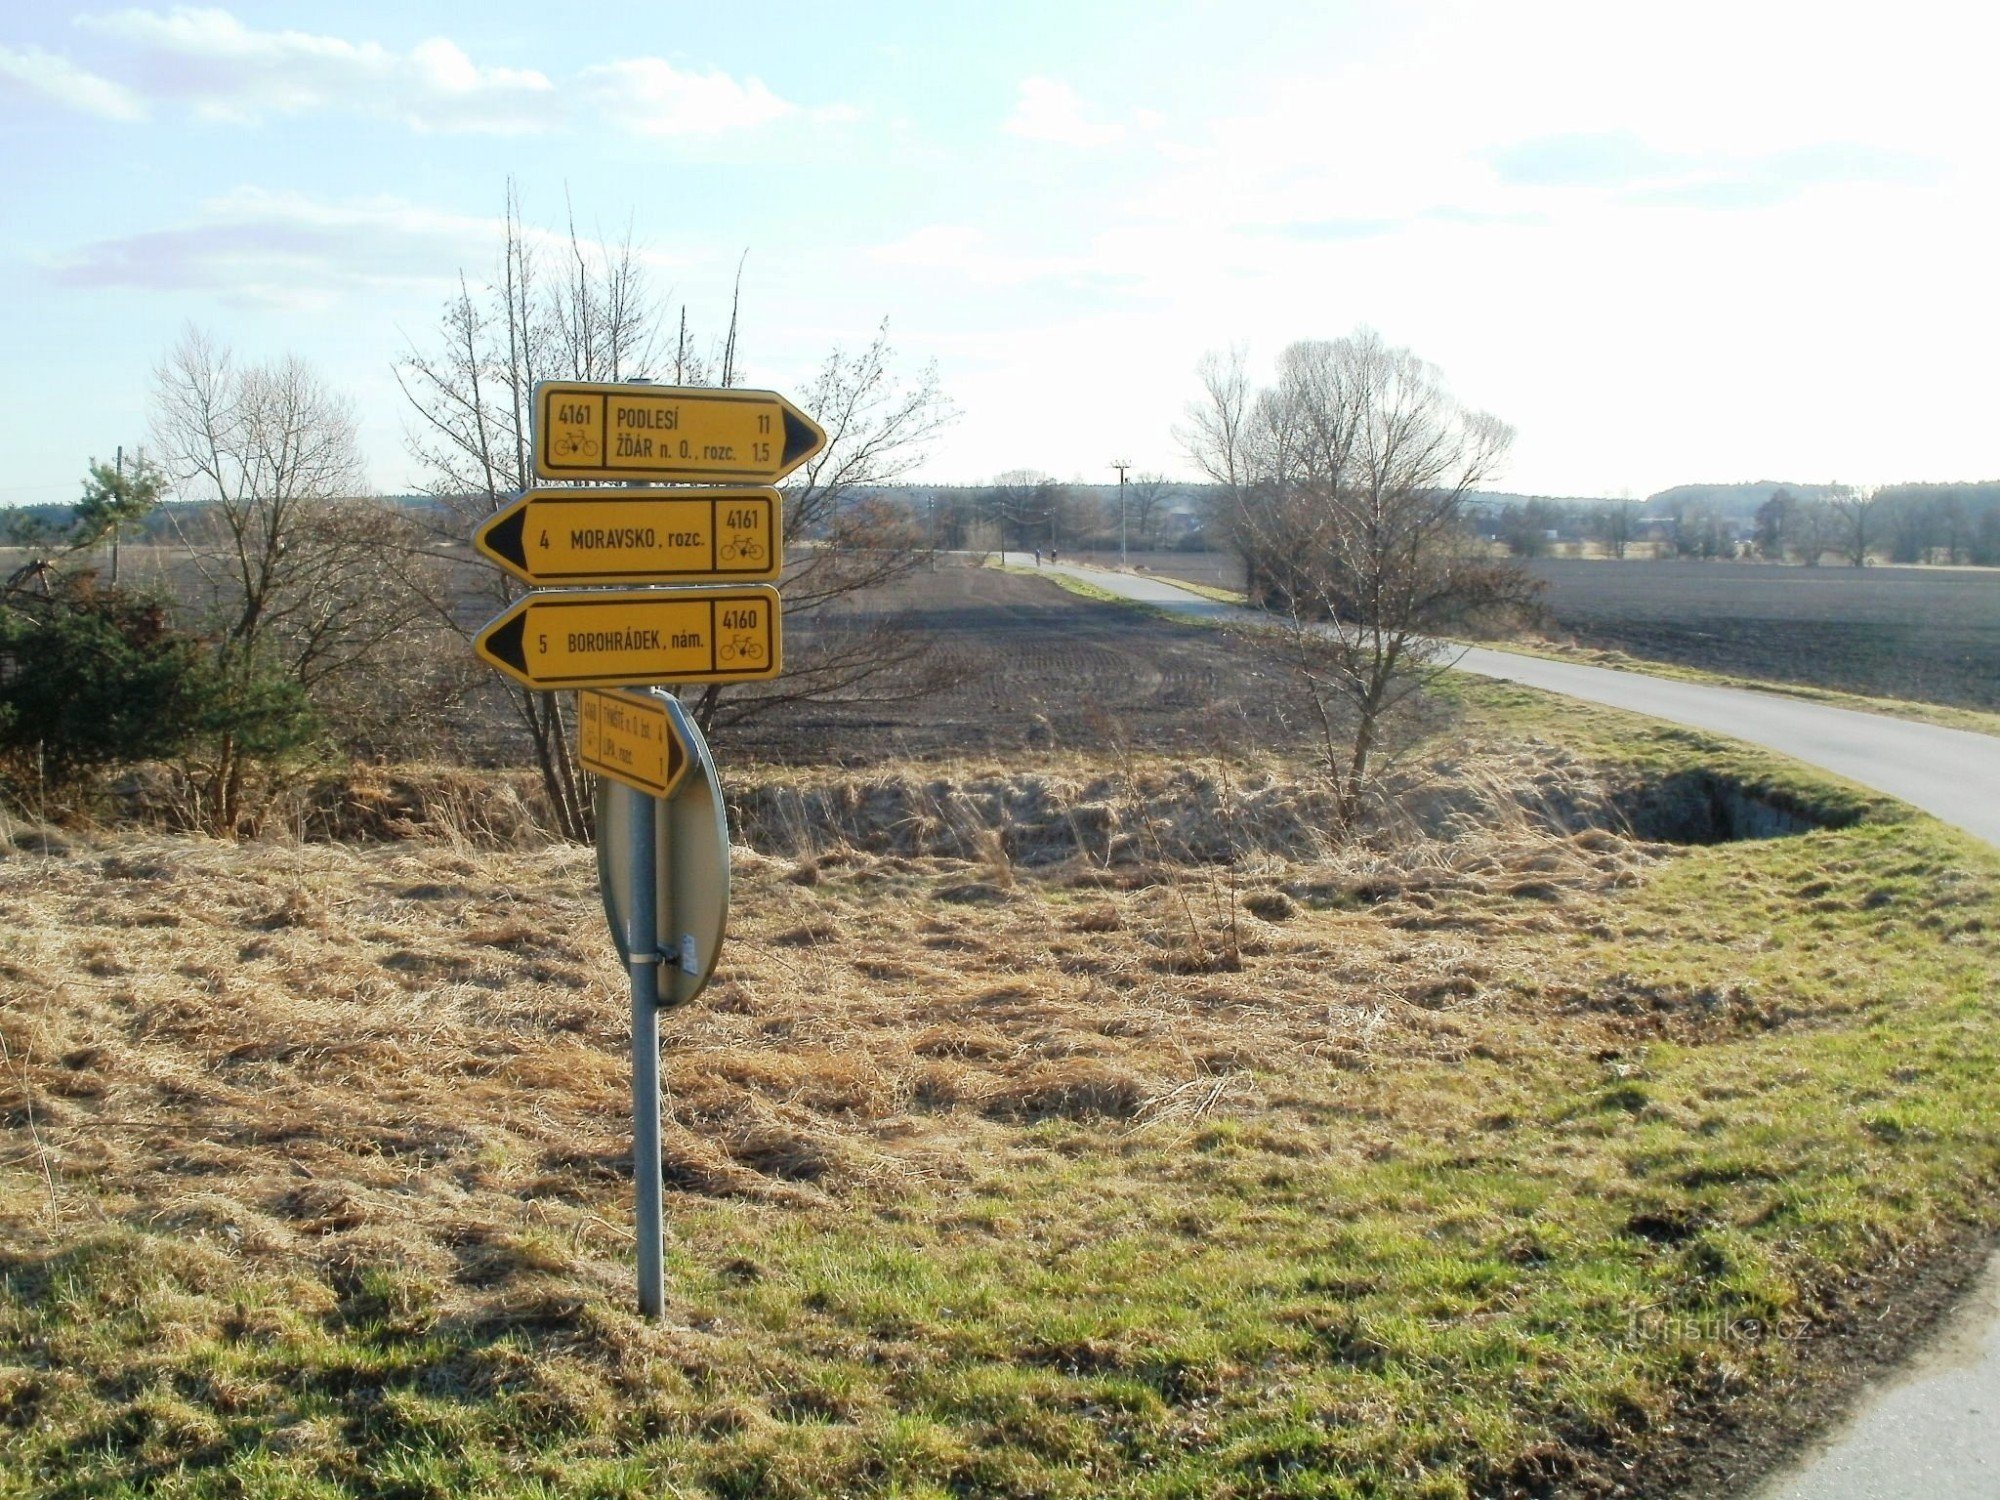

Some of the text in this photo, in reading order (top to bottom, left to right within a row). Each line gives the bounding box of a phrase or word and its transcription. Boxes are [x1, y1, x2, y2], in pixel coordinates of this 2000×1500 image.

[558, 404, 591, 425] 4161
[617, 405, 770, 434] PODLESÍ 11
[616, 433, 653, 459] ŽĎÁR
[659, 444, 672, 459] n.
[703, 444, 737, 462] rozc.
[752, 442, 770, 463] 1,5
[727, 509, 759, 530] 4161
[539, 532, 550, 550] 4
[668, 530, 706, 547] rozc.
[723, 609, 757, 630] 4160
[539, 625, 704, 654] 5 BOROHRÁDEK, nám.
